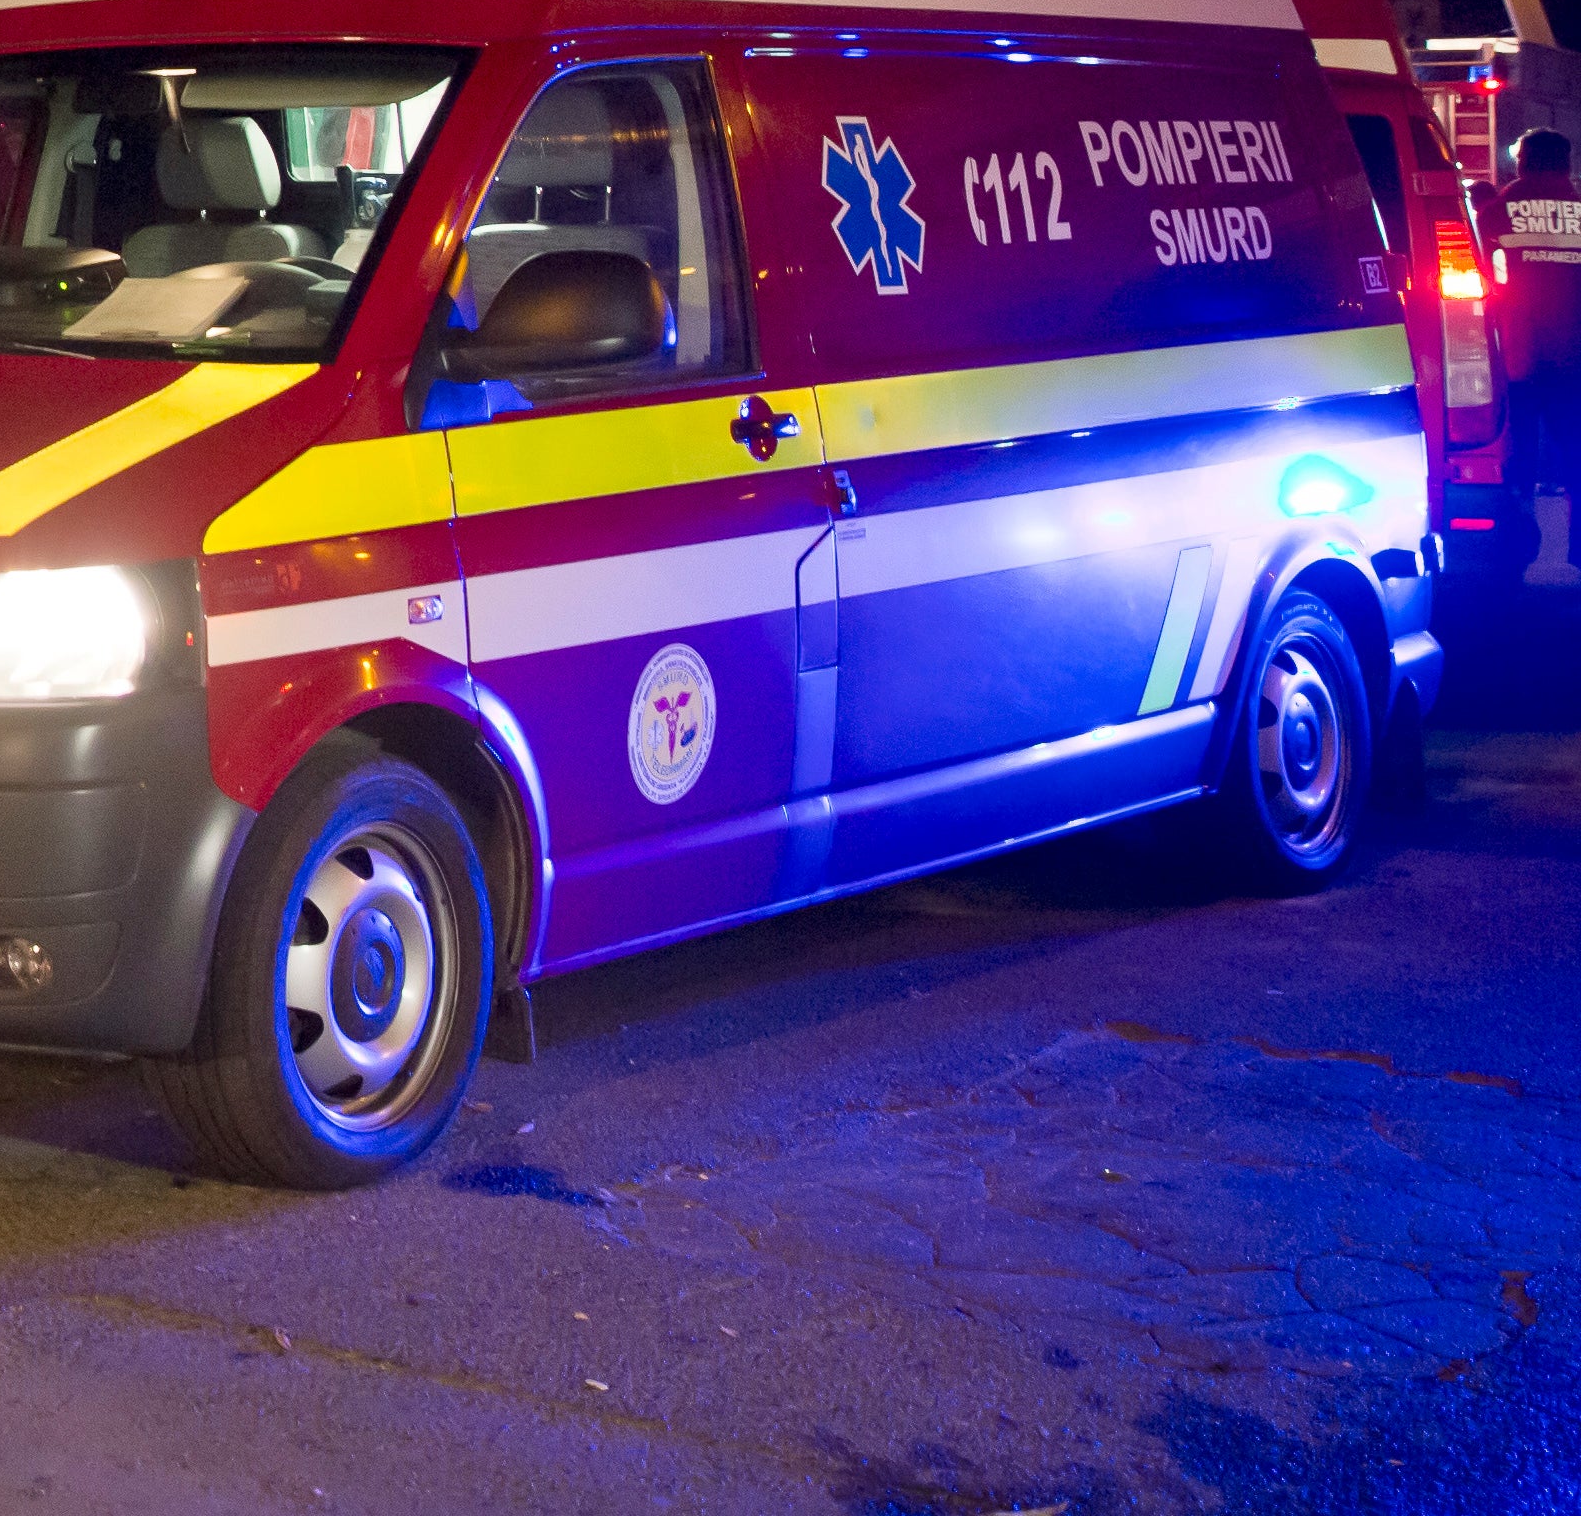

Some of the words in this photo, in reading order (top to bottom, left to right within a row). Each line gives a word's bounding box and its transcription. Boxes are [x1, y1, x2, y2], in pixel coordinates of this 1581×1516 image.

[993, 151, 1072, 245] 112
[1079, 119, 1294, 187] POMPIERII
[1150, 206, 1274, 267] SMURD
[1511, 216, 1581, 234] SMUR
[1367, 262, 1383, 287] B2
